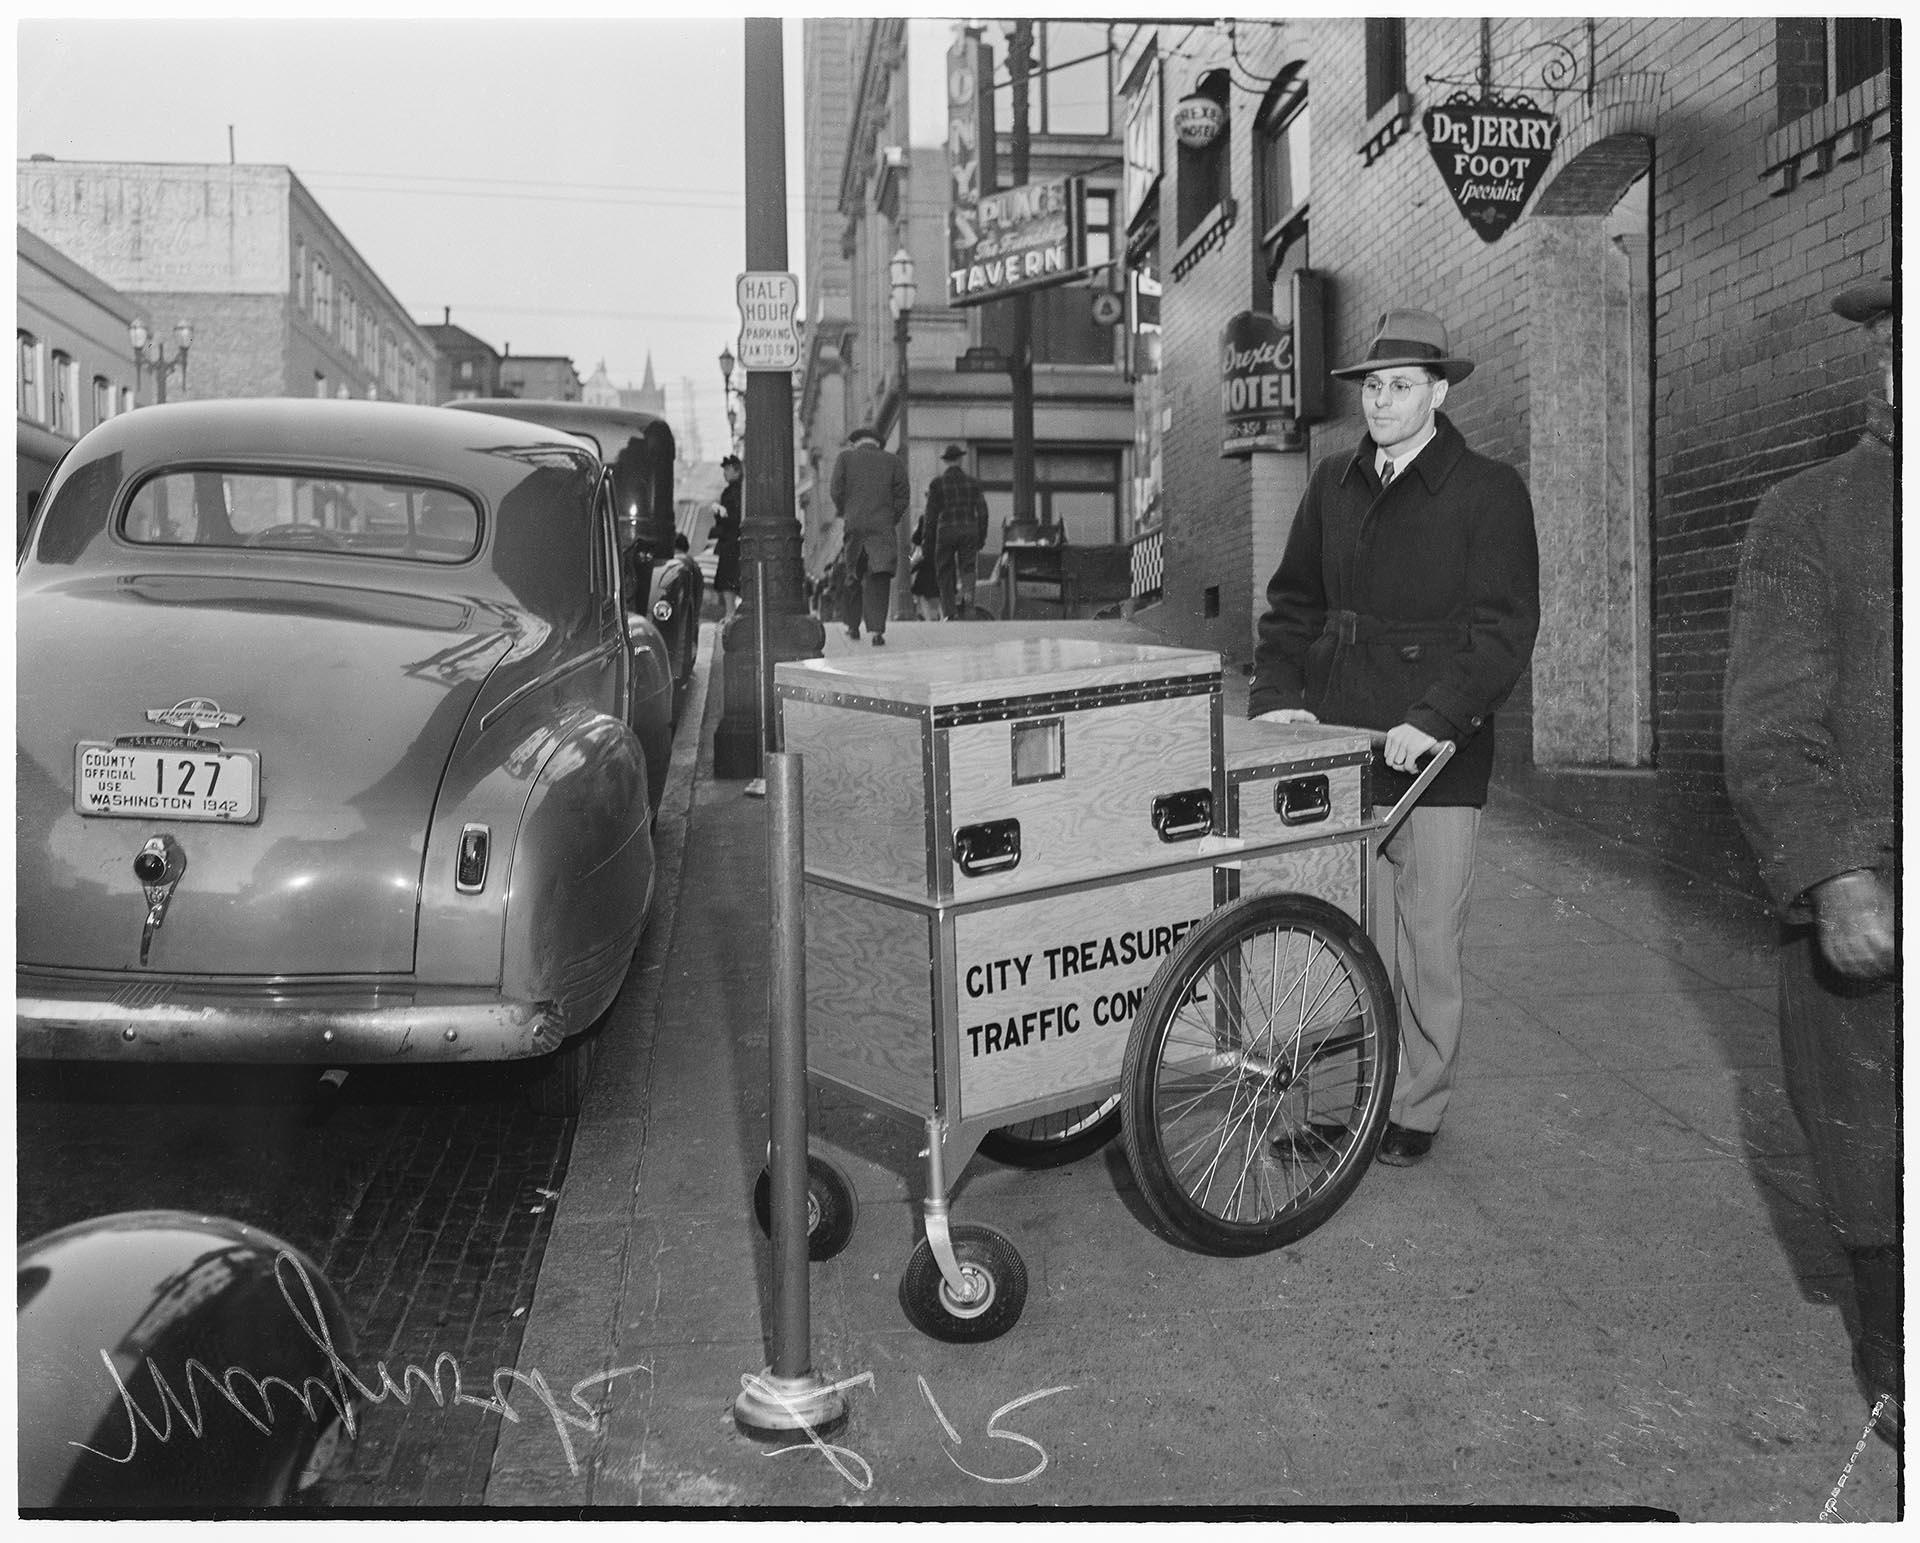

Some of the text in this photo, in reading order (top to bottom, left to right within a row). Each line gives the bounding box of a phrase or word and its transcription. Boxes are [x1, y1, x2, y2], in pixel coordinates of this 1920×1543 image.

[1182, 124, 1216, 138] HOTEL
[1454, 154, 1531, 179] FOOT
[1458, 179, 1525, 205] Specialist
[978, 183, 1066, 230] PLACE
[950, 245, 1066, 294] TAVERN
[745, 281, 788, 299] HALF
[745, 303, 789, 321] HOUR
[745, 327, 791, 340] PARKING
[1223, 335, 1293, 374] Drexel
[1221, 374, 1295, 414] HOTEL
[86, 754, 136, 768] COUNTY
[85, 768, 136, 781] OFFICIAL
[98, 782, 122, 792] USE
[156, 758, 221, 797] 127
[89, 793, 238, 813] WASHINGTON 1942
[965, 919, 1201, 998] CITY TREASURE
[966, 1003, 1081, 1057] TRAFFIC
